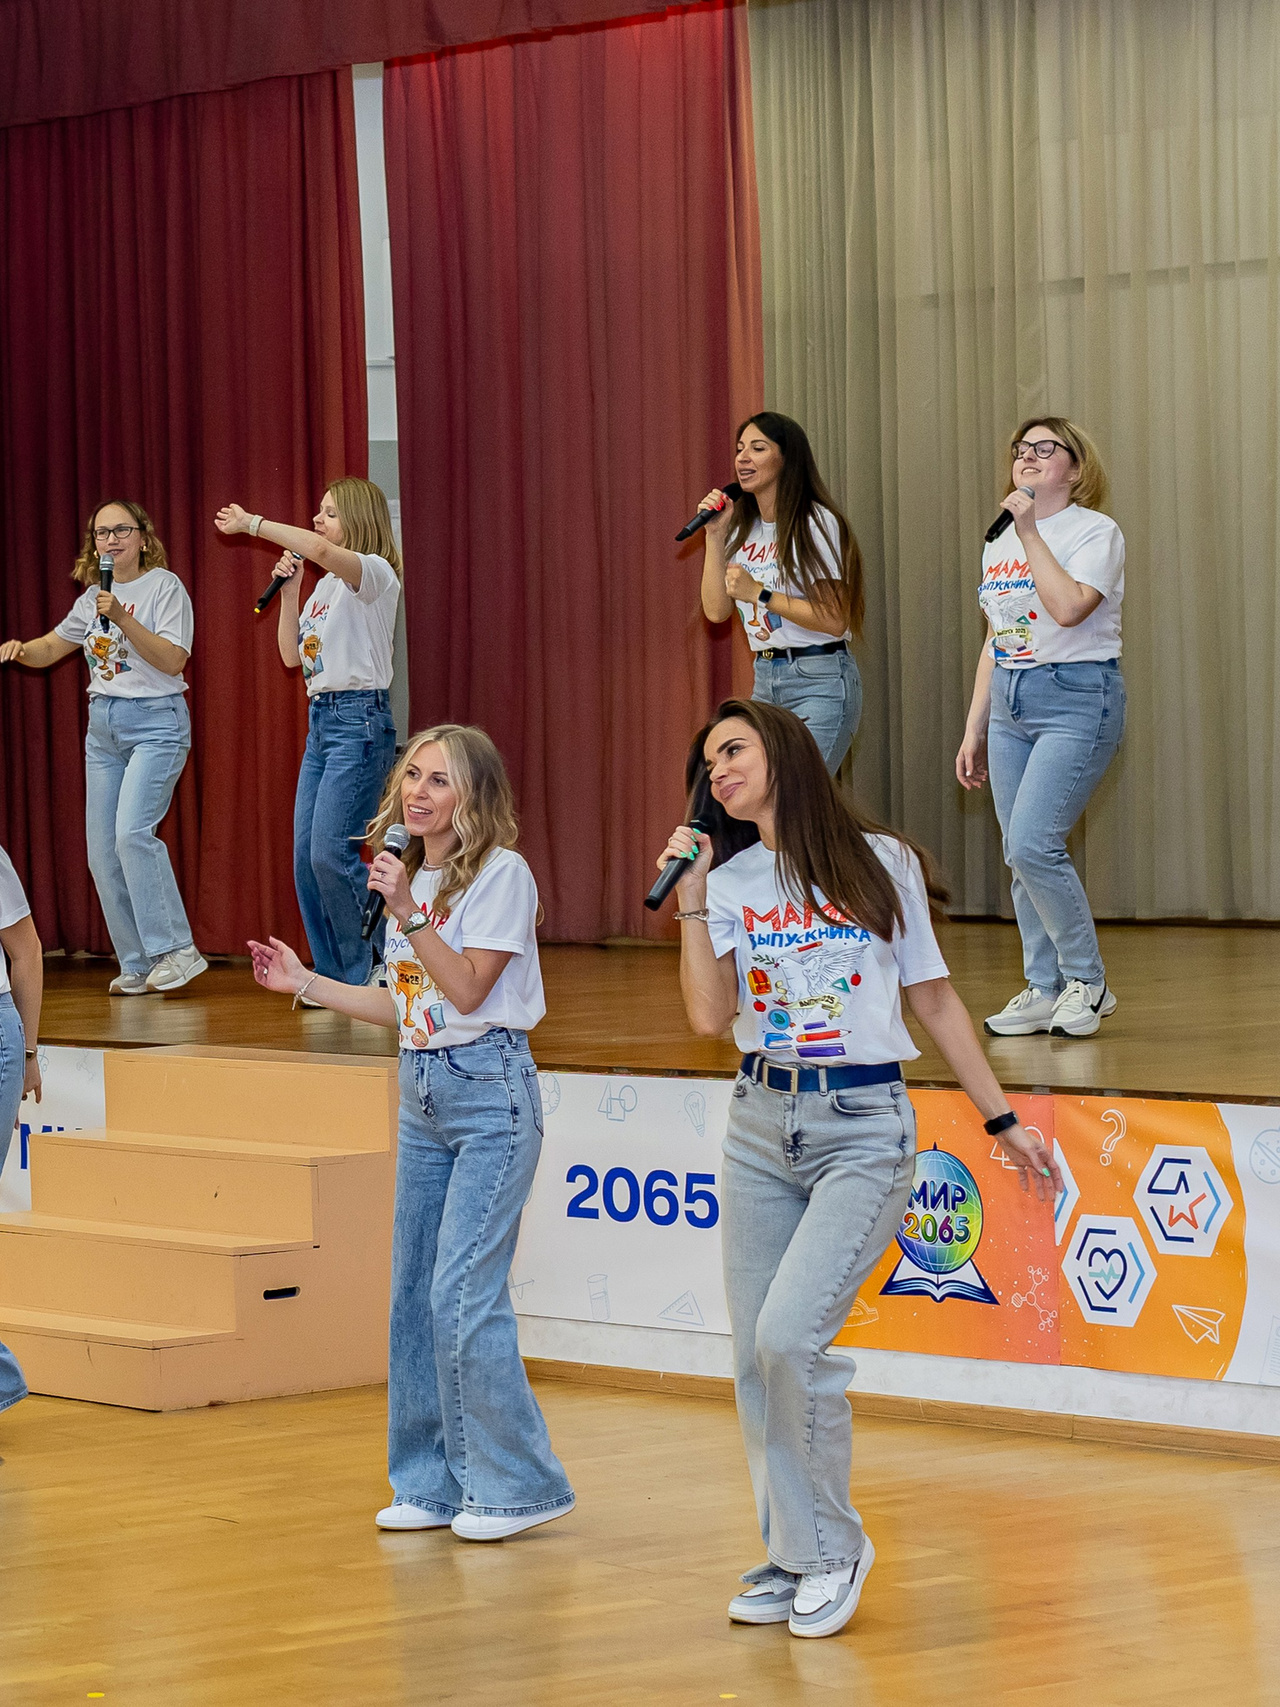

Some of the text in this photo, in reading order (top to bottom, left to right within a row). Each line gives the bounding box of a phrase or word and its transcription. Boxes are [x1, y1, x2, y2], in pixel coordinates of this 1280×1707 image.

[399, 973, 420, 986] 2025
[566, 1164, 720, 1229] 2065
[908, 1181, 966, 1211] МИР
[904, 1212, 971, 1244] 2065
